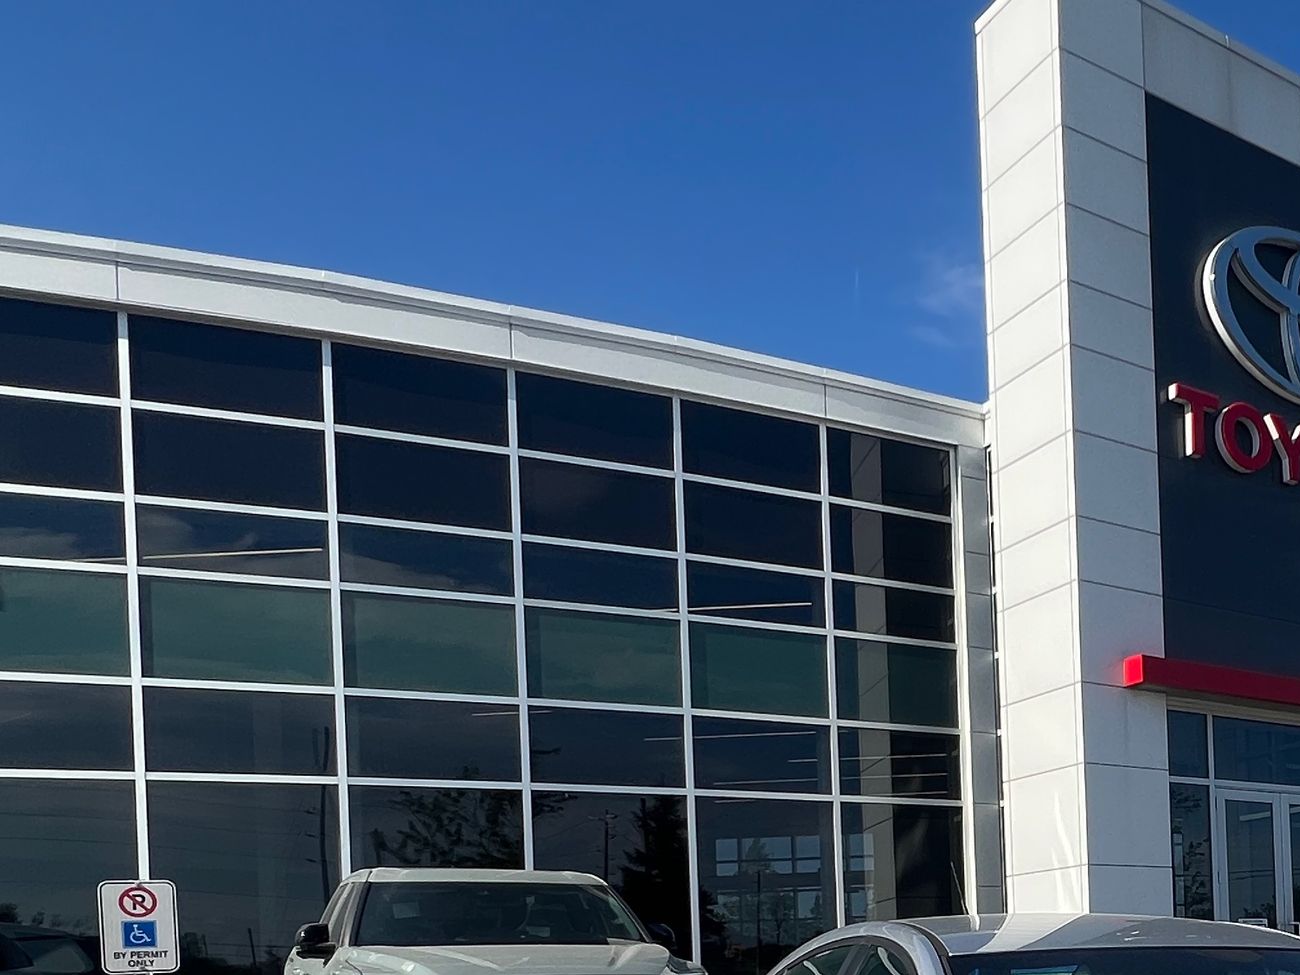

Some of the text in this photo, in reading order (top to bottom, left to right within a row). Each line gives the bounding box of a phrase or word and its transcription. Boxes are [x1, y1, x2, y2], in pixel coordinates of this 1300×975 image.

[113, 950, 168, 960] BY PERMIT
[128, 959, 155, 967] ONLY
